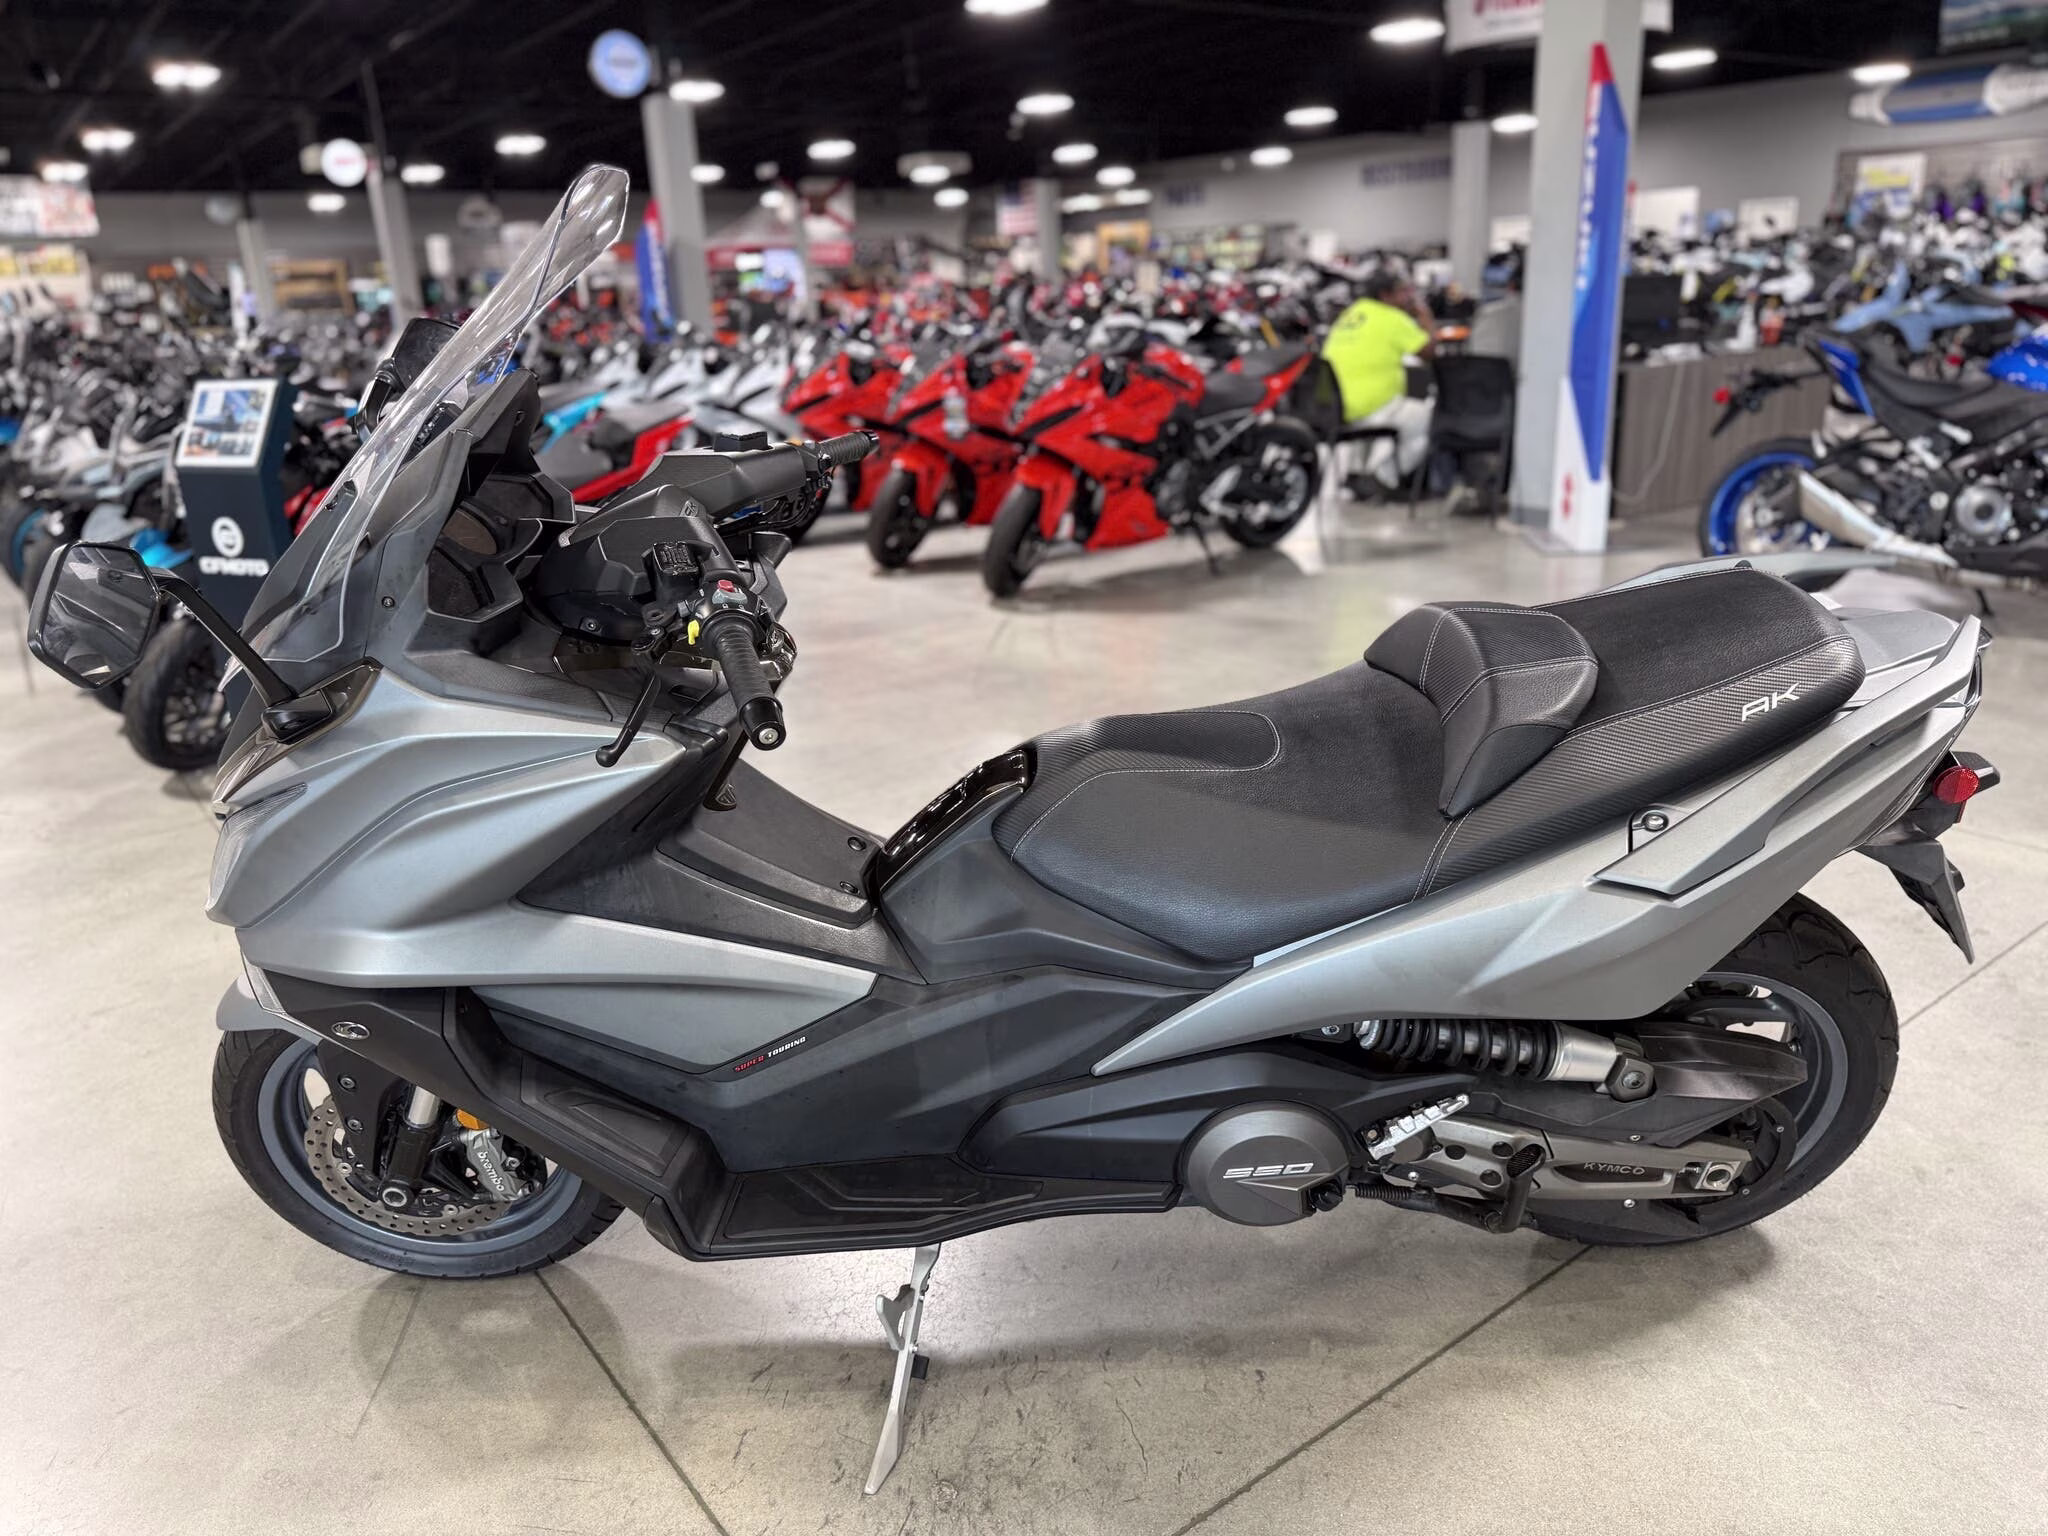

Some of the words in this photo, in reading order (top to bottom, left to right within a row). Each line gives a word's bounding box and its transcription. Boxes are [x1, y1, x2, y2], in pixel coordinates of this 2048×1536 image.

[1741, 682, 1801, 722] AK
[734, 1055, 765, 1073] SUPER
[767, 1036, 807, 1058] TOURING
[477, 1151, 505, 1191] brembo
[1222, 1162, 1315, 1179] 550
[1583, 1161, 1646, 1176] KYMCO
